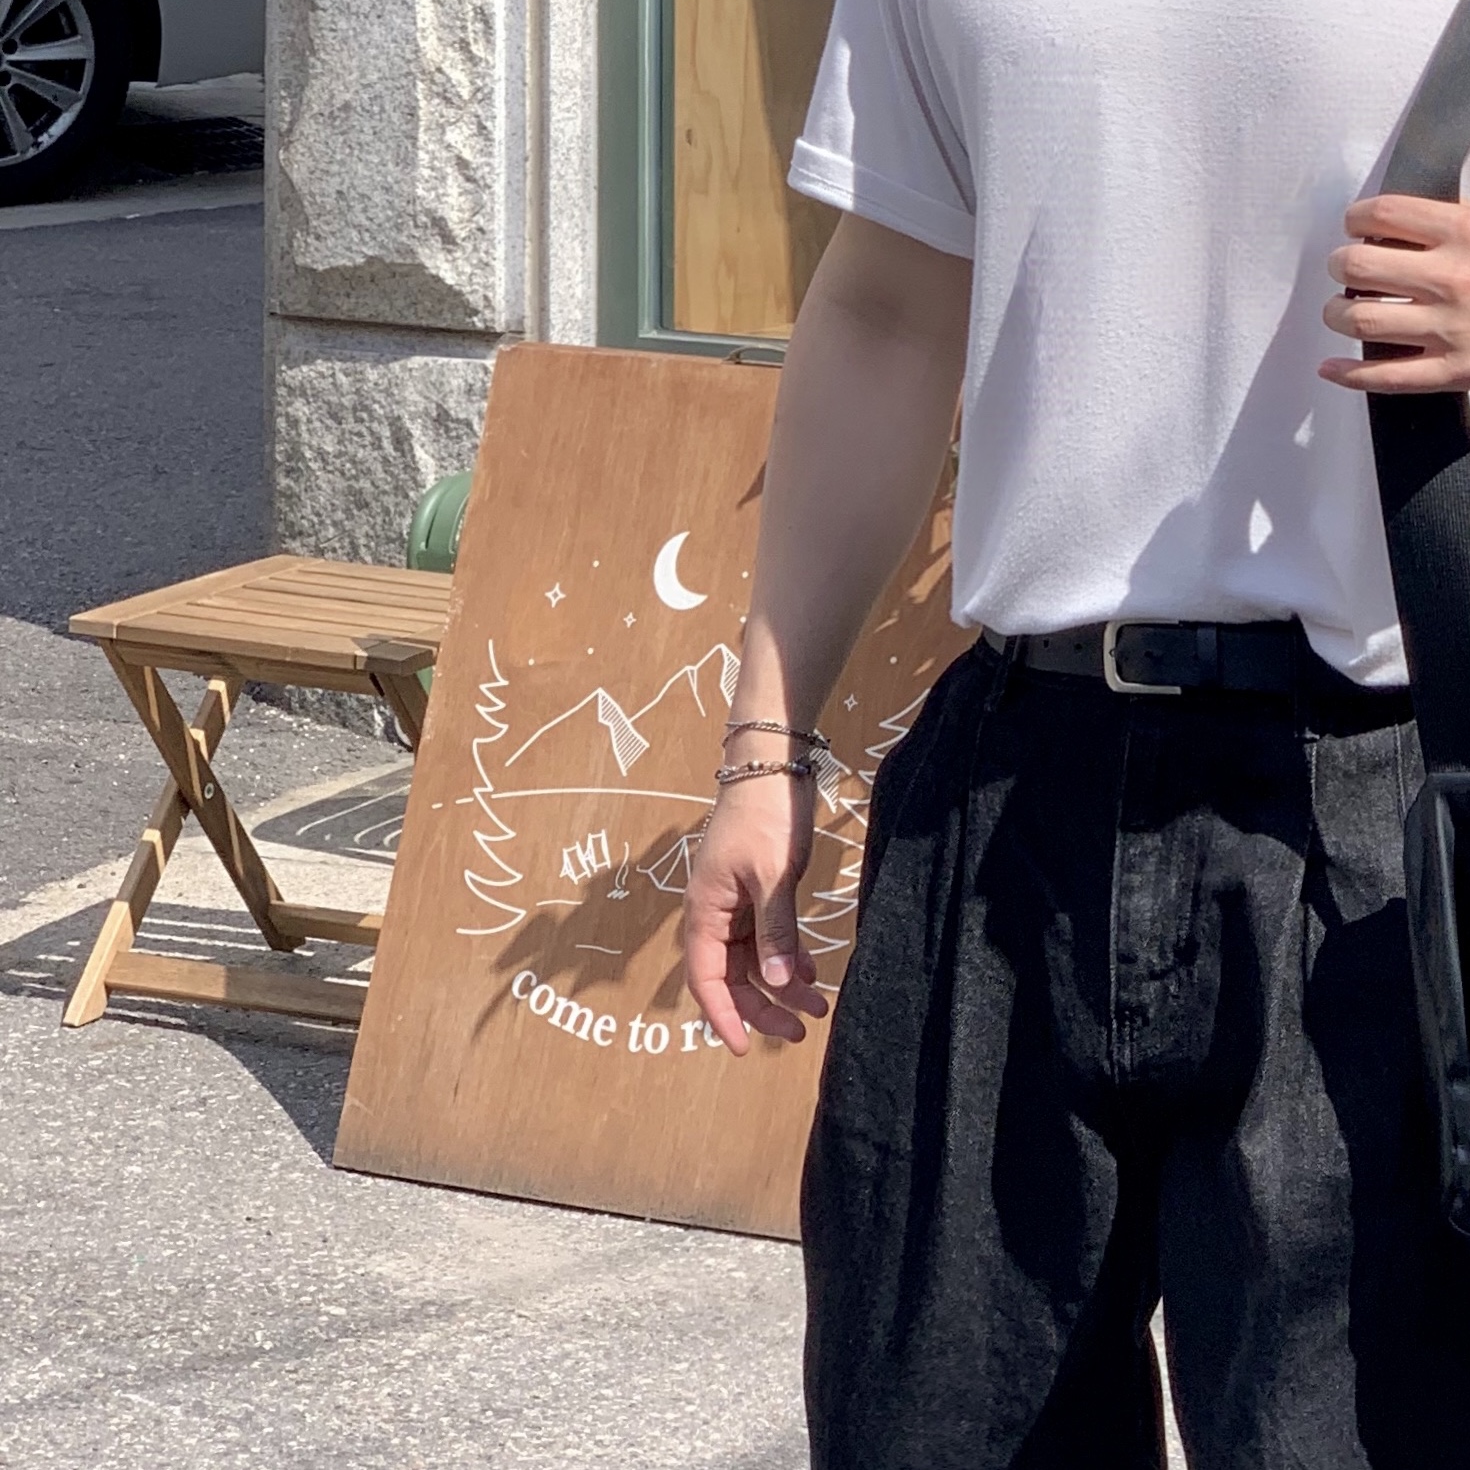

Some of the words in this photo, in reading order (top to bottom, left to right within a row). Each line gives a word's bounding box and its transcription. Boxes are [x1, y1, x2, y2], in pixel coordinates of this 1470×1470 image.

[511, 970, 617, 1047] come
[628, 1012, 670, 1054] to
[680, 1019, 751, 1053] re
